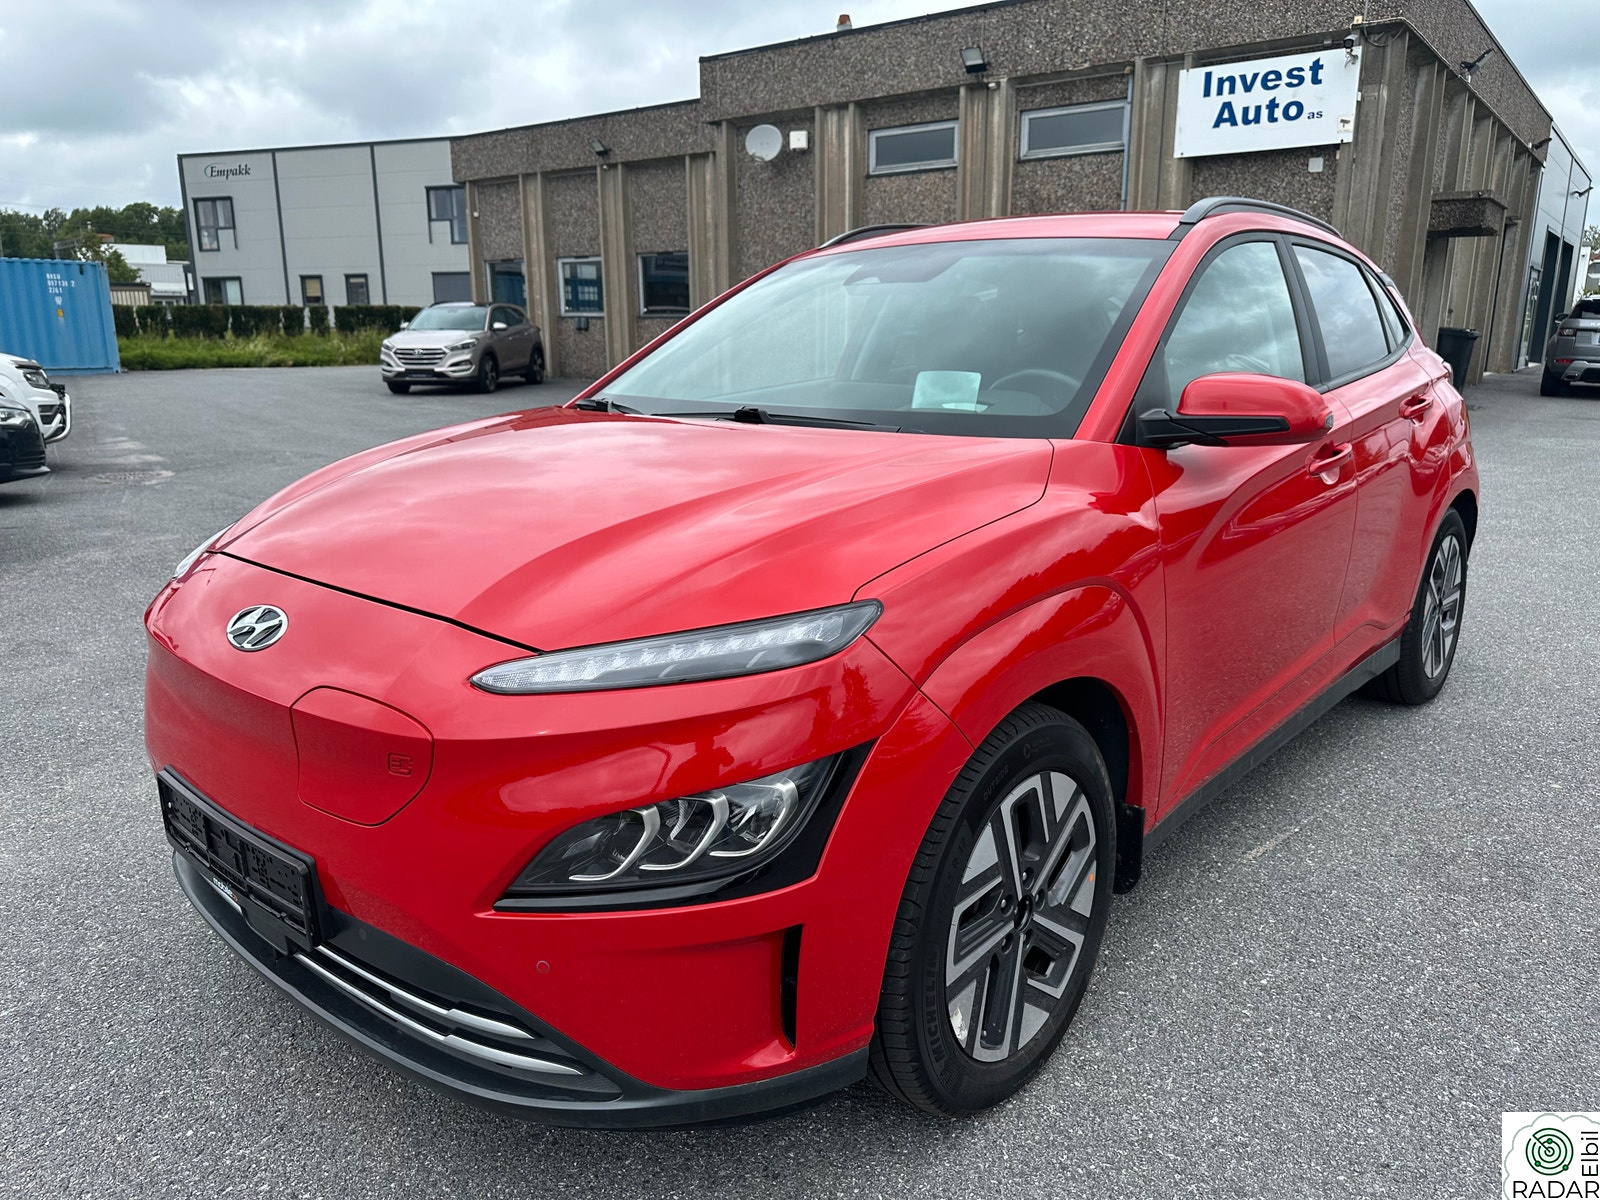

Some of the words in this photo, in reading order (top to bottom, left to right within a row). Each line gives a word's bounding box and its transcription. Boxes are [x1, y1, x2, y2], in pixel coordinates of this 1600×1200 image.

[1203, 58, 1324, 98] Invest
[1212, 97, 1304, 128] Auto
[1307, 110, 1323, 120] as
[209, 163, 251, 180] Empakk
[926, 957, 946, 1064] MICHELIN
